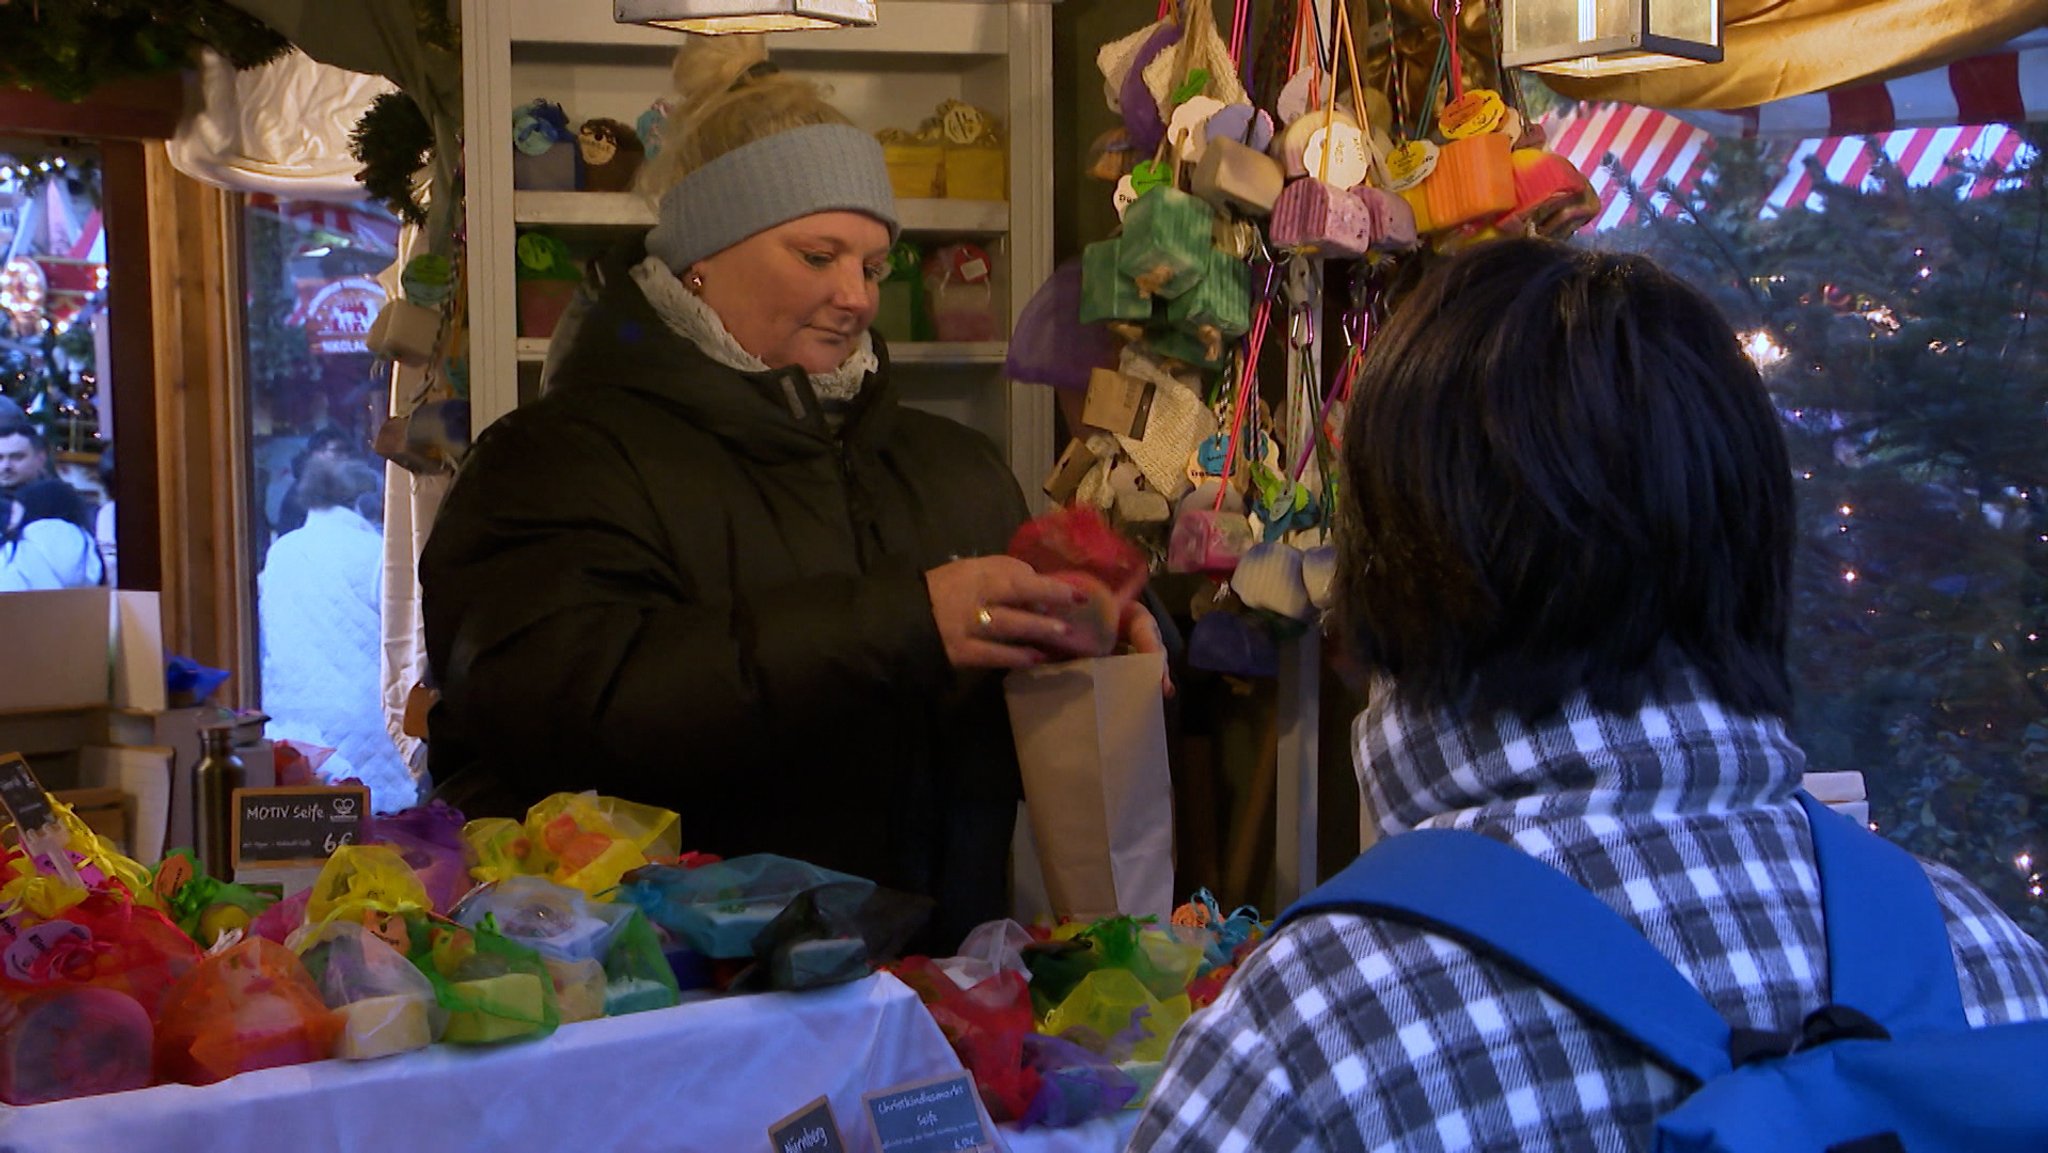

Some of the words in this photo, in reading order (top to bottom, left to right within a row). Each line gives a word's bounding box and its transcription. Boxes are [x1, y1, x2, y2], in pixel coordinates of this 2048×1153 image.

[321, 340, 369, 353] NIKOLA
[247, 804, 290, 822] MOTIV
[292, 803, 325, 823] Seife
[783, 1126, 829, 1153] Nürnberg
